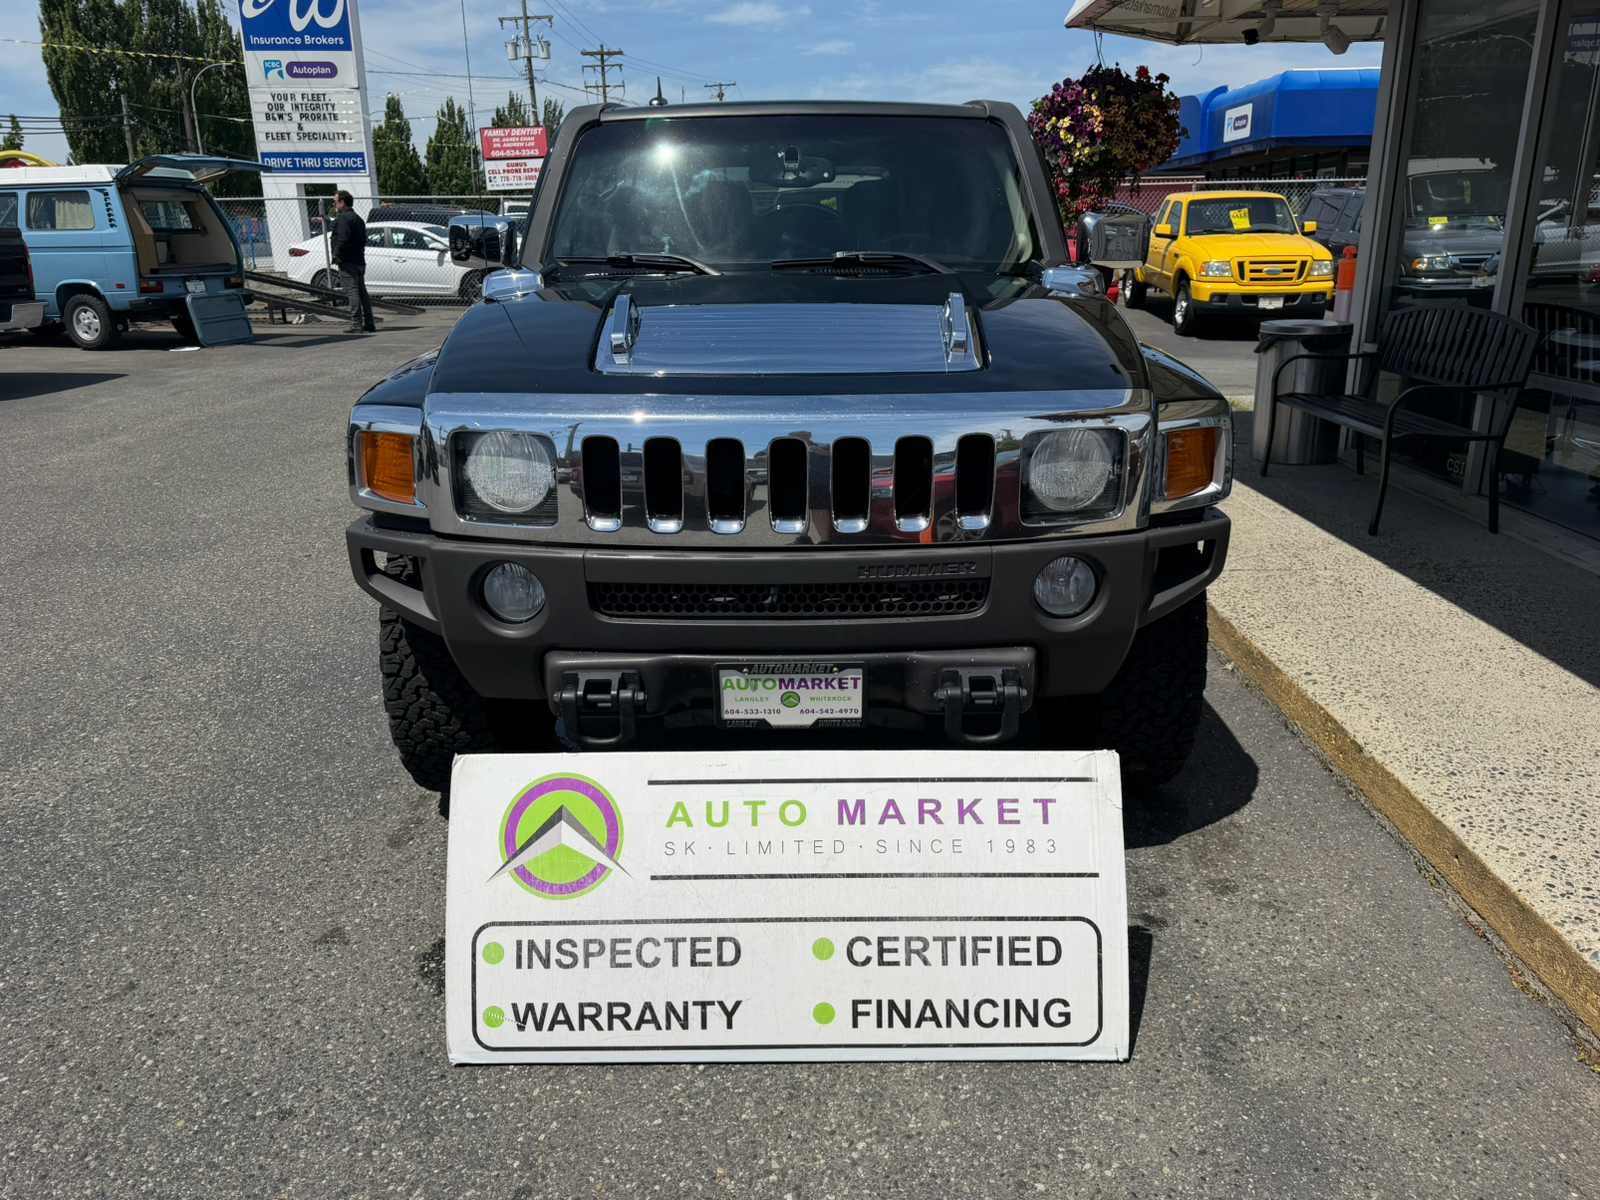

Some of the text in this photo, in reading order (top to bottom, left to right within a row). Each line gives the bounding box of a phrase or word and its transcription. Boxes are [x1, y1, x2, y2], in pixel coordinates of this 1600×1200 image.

[250, 35, 344, 45] Insurance Brokers
[292, 65, 331, 76] Autoplan
[270, 93, 296, 102] YOUR
[267, 103, 336, 111] OUR INTEGRITY
[265, 113, 339, 121] B&W'S PRORATE
[297, 122, 304, 131] &
[265, 132, 291, 141] FLEET
[483, 128, 543, 137] FAMILY DENTIST
[490, 149, 539, 157] 604-534-3343
[263, 157, 364, 168] DRIVE THRU SERVICE
[858, 561, 977, 579] HUMMER
[750, 663, 834, 674] AUTOMARKET
[722, 677, 862, 691] AUTOMARKET
[726, 720, 758, 728] LANGLEY
[665, 798, 1057, 829] AUTO MARKET
[986, 838, 1058, 854] 1983
[514, 936, 743, 970] INSPECTED
[846, 935, 1064, 968] CERTIFIED
[511, 999, 744, 1032] WARRANTY
[851, 997, 1073, 1029] FINANCING
